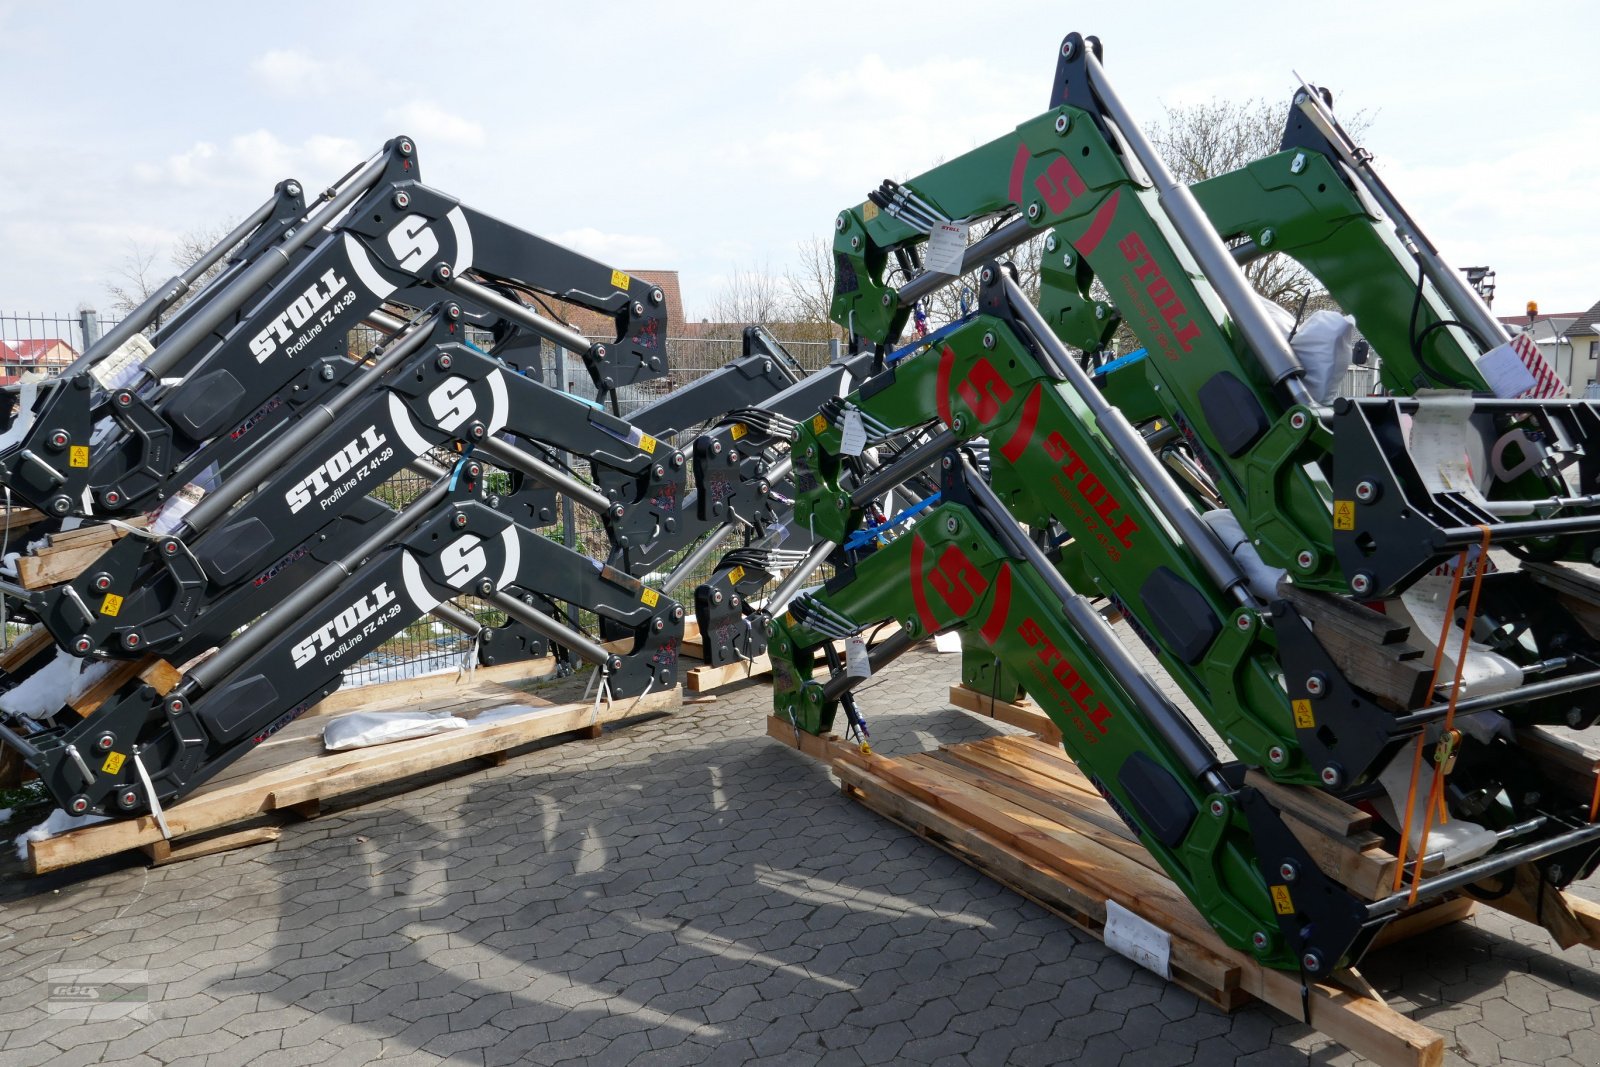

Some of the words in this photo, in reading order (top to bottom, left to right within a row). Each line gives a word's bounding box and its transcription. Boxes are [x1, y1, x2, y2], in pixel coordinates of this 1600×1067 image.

[1034, 156, 1086, 215] S
[387, 215, 439, 273] S
[249, 267, 347, 364] STOLL
[285, 323, 322, 358] ProfiLine
[320, 310, 334, 326] FZ
[333, 290, 356, 315] 41-29
[1118, 231, 1201, 352] STOLL
[428, 377, 476, 432] S
[957, 357, 1013, 424] S
[285, 425, 386, 514] STOLL
[320, 479, 357, 510] ProfiLine
[356, 465, 370, 481] FZ
[370, 447, 394, 469] 41-29
[1043, 431, 1140, 550] STOLL
[440, 534, 487, 589] S
[927, 544, 988, 617] S
[291, 582, 396, 669] STOLL
[324, 634, 362, 665] ProfiLine
[363, 622, 376, 637] FZ
[376, 604, 401, 626] 41-29
[1018, 617, 1113, 735] STOLL
